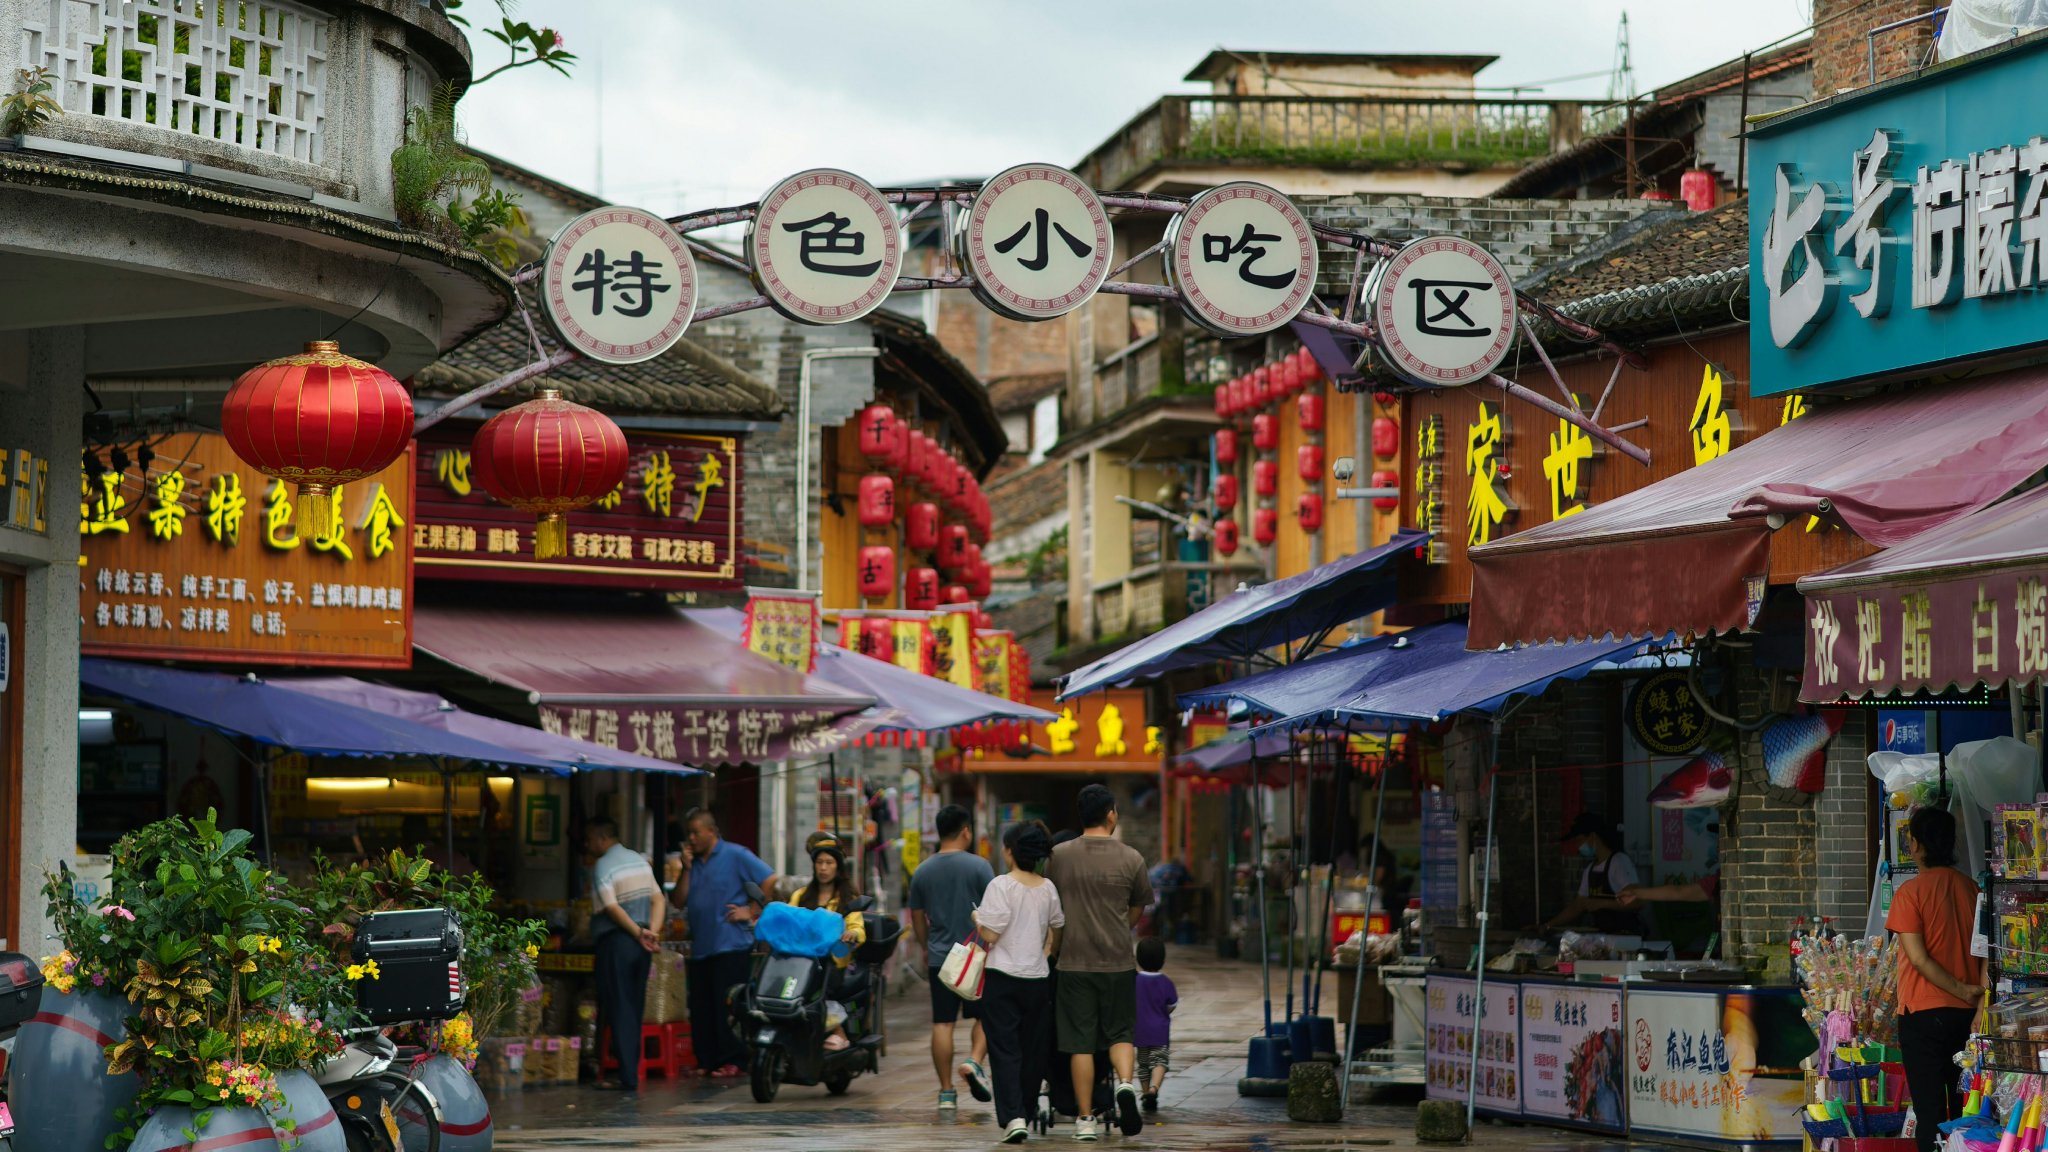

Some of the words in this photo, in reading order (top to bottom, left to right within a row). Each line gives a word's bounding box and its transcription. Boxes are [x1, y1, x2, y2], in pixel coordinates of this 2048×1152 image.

[643, 538, 716, 565] 可批发零售
[684, 709, 729, 757] 干货
[738, 708, 783, 757] 特产
